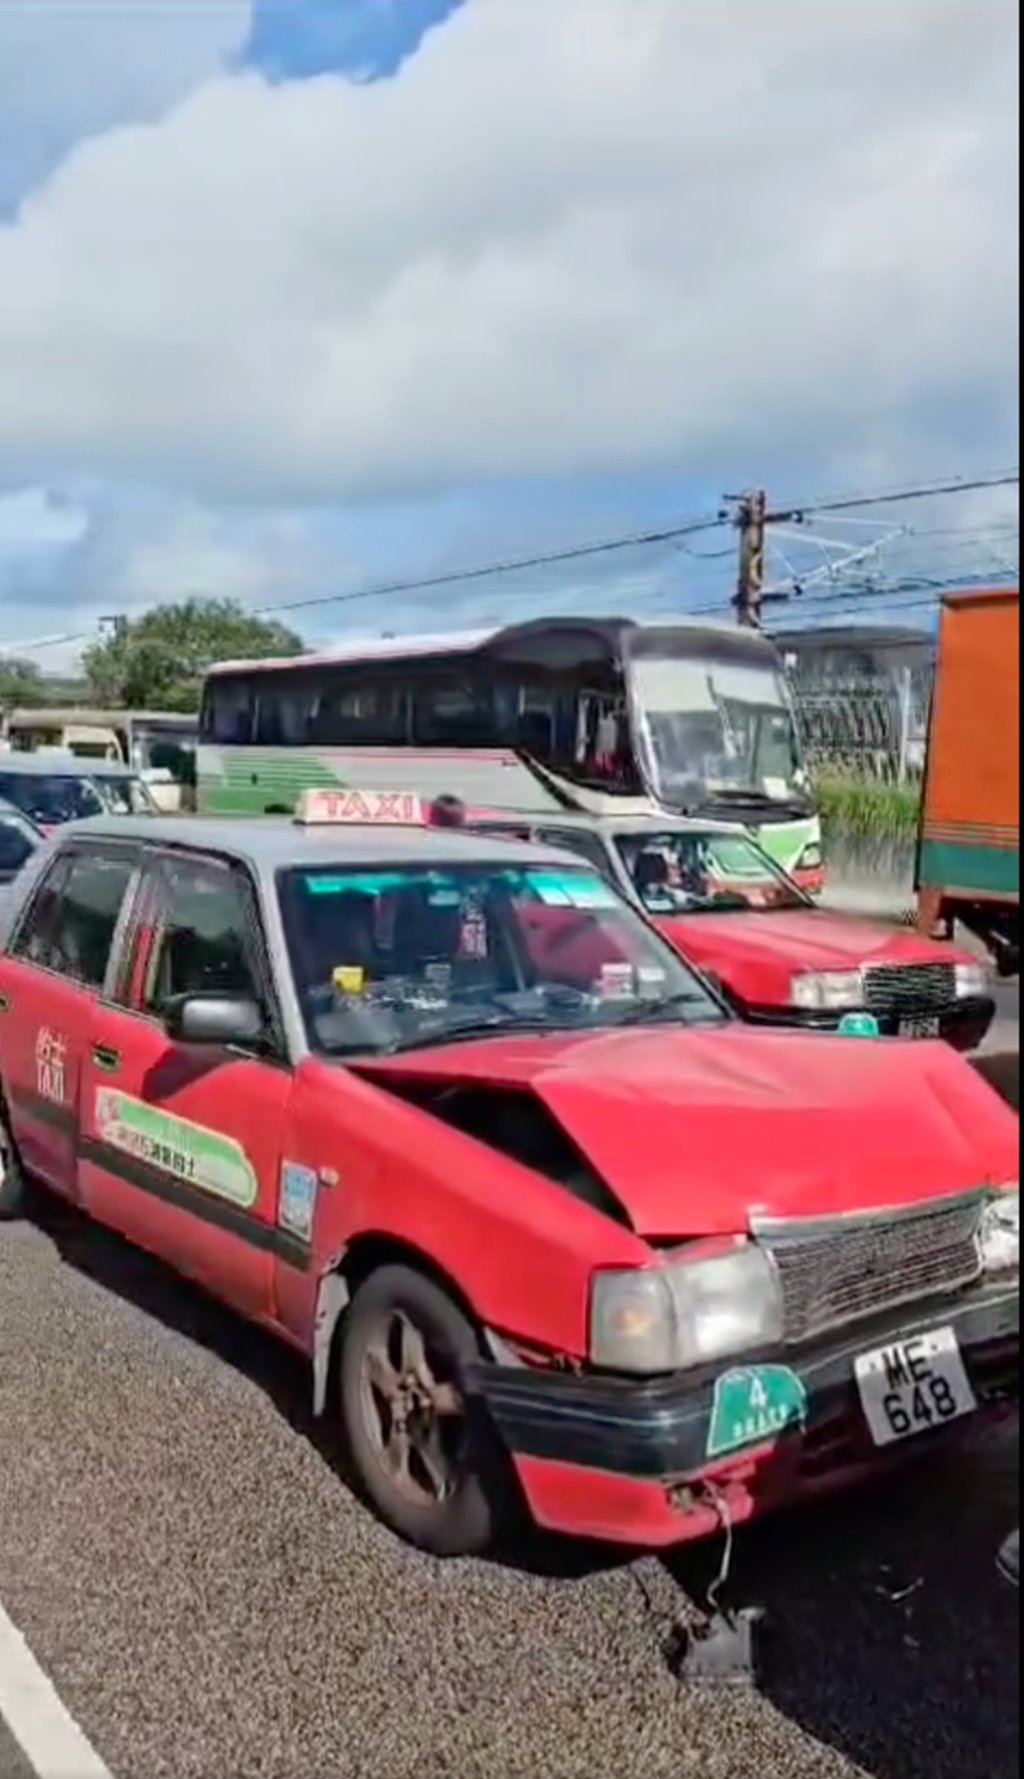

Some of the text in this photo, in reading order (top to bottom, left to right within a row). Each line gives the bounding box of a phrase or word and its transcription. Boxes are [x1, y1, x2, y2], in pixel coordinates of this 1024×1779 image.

[315, 790, 414, 819] TAXI
[36, 1057, 64, 1103] TAXI
[881, 1341, 933, 1390] ME
[749, 1377, 768, 1408] 4
[883, 1375, 957, 1434] 648
